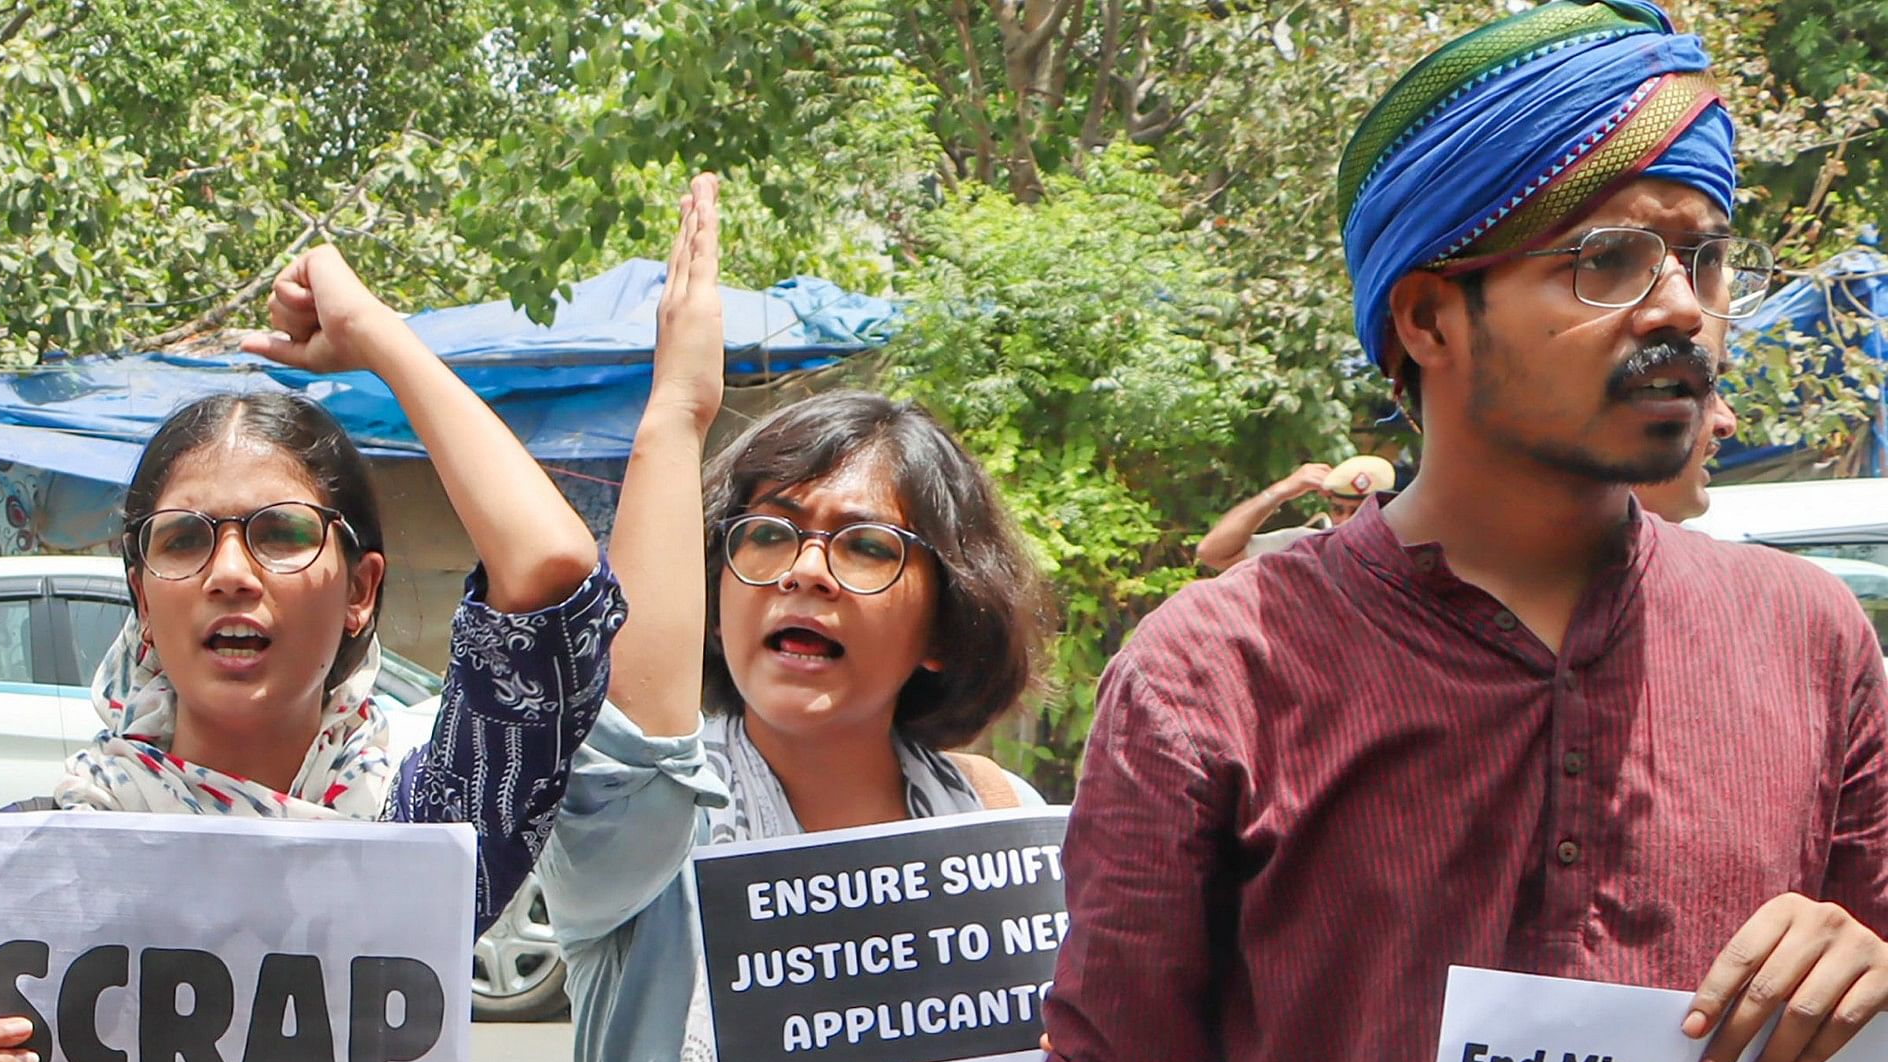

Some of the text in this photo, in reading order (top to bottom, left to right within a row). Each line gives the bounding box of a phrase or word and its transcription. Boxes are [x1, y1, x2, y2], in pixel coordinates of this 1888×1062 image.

[748, 844, 1062, 920] ENSURE SWIFT
[731, 931, 917, 993] JUSTICE
[929, 923, 991, 968] TO
[782, 981, 1053, 1054] APPLICANT
